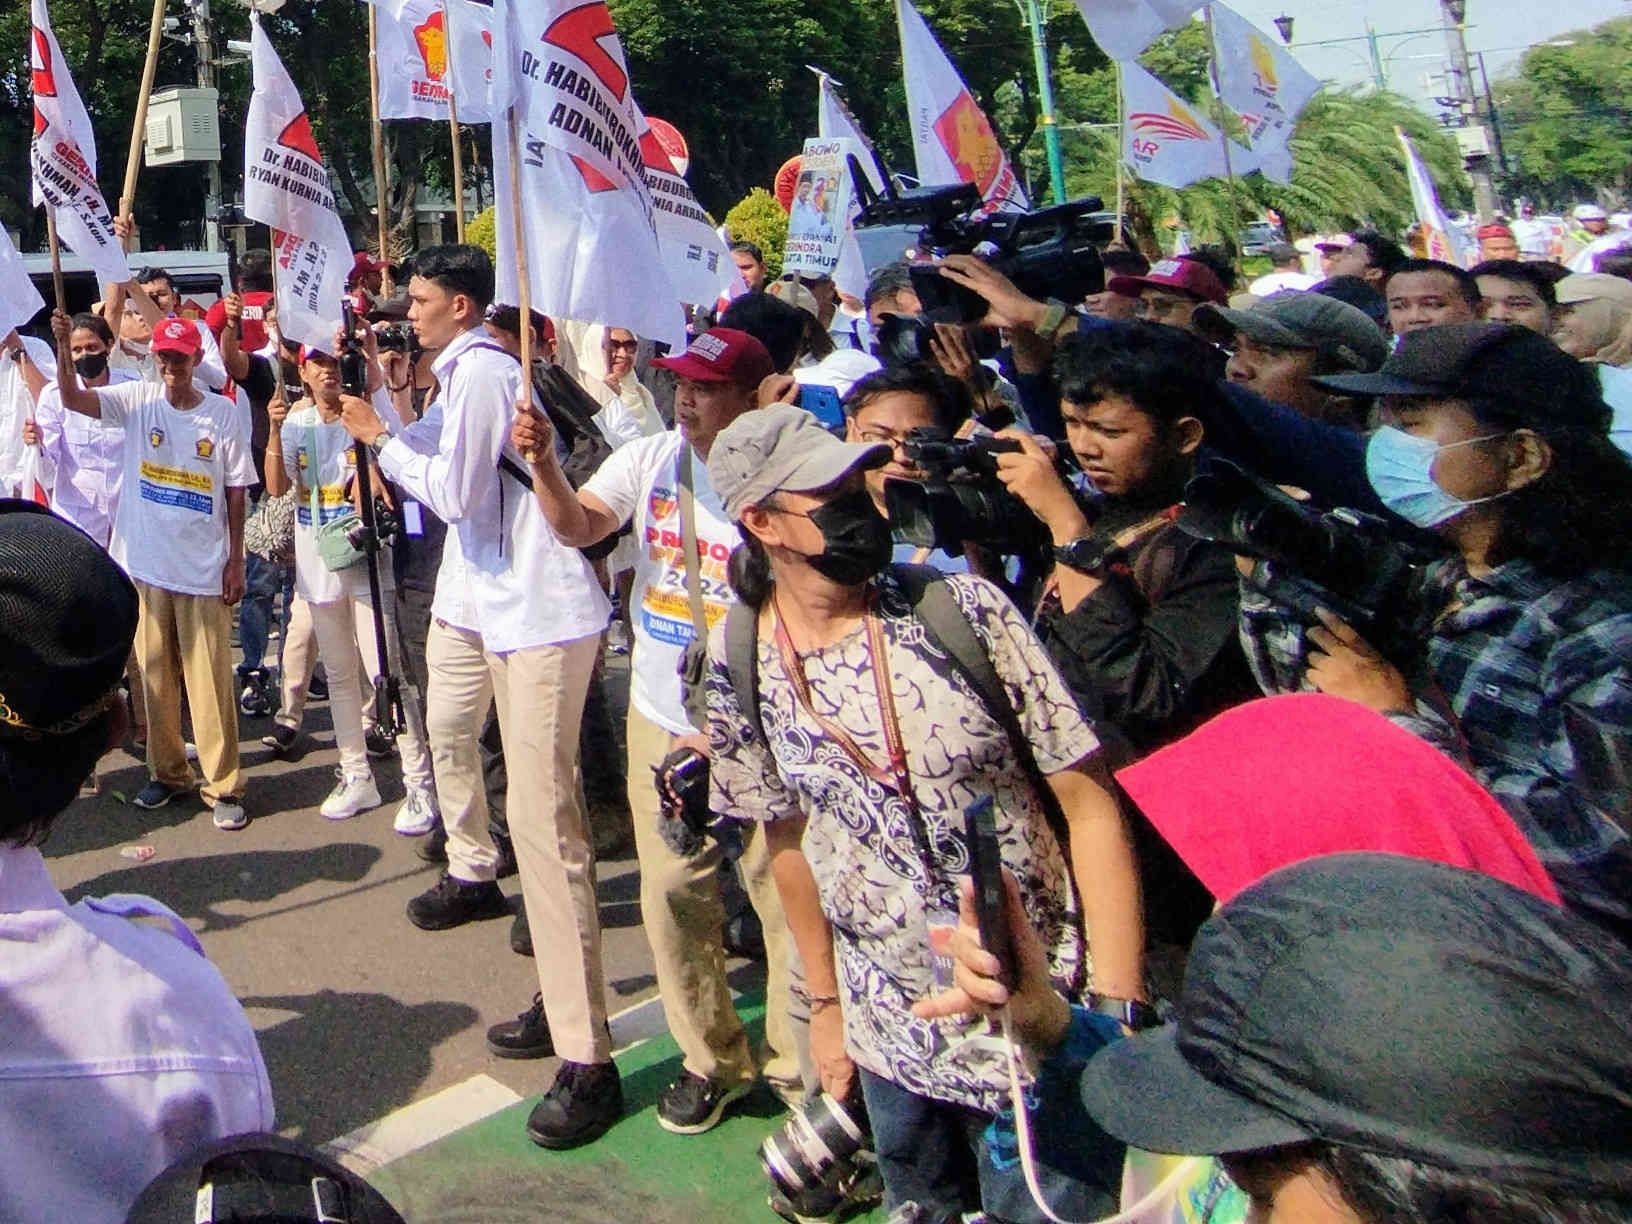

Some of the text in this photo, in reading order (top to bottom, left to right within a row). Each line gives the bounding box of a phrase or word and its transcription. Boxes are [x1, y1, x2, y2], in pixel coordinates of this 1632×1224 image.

[521, 49, 539, 81] Dr.
[547, 101, 614, 162] ADNAN
[262, 147, 280, 168] Dr.
[249, 165, 282, 188] RYAN
[280, 178, 322, 207] KURNIA
[804, 254, 838, 268] TIMUR
[645, 526, 730, 562] PRBO
